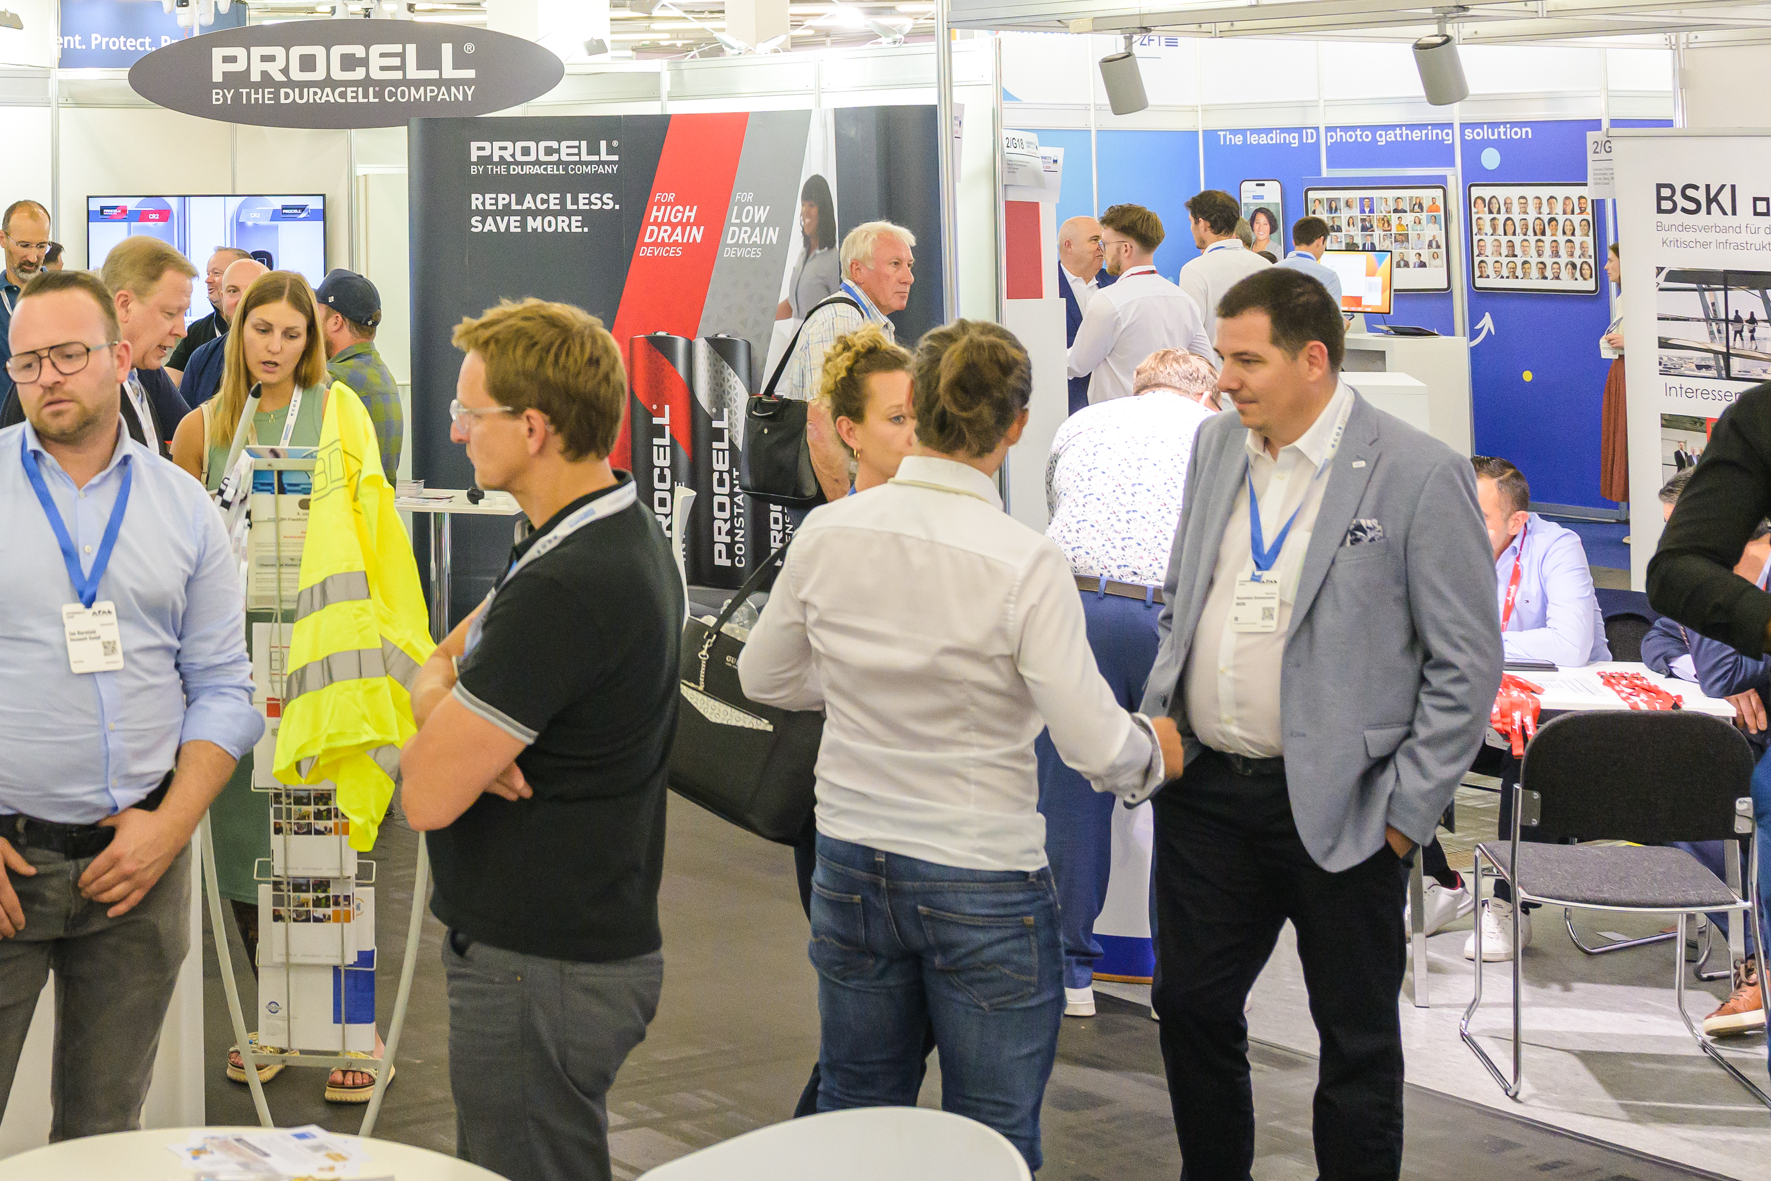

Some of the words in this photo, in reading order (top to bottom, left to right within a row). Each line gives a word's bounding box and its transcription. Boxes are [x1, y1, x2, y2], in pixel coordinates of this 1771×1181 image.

[57, 35, 86, 49] ent.
[91, 33, 156, 51] Protect.
[212, 88, 234, 105] BY
[239, 88, 275, 104] THE
[384, 85, 476, 102] COMPANY
[1005, 137, 1025, 149] 2/G18
[1218, 131, 1243, 145] The
[1247, 129, 1299, 147] leading
[1303, 129, 1317, 143] ID
[1327, 127, 1372, 146] photo
[1377, 126, 1453, 145] gathering
[1464, 124, 1532, 141] solution
[1592, 140, 1613, 154] 2/G
[470, 165, 484, 175] BY
[486, 165, 507, 175] THE
[568, 164, 619, 174] COMPANY
[471, 193, 561, 210] REPLACE
[566, 193, 620, 210] LESS.
[654, 192, 676, 203] FOR
[735, 192, 754, 203] FOR
[1655, 182, 1737, 216] BSKI
[649, 205, 698, 223] HIGH
[730, 205, 770, 224] LOW
[470, 215, 521, 232] SAVE
[527, 215, 588, 232] MORE.
[1656, 221, 1742, 235] Bundesverband
[1745, 223, 1762, 235] für
[1764, 224, 1771, 235] d
[643, 225, 704, 243] DRAIN
[726, 226, 780, 245] DRAIN
[639, 246, 683, 257] DEVICES
[723, 247, 762, 258] DEVICES
[1661, 237, 1713, 250] Kritischer
[1716, 239, 1771, 252] Infrastrukt
[1664, 382, 1742, 402] Interessen
[652, 404, 672, 538] ROCELL
[711, 407, 731, 567] PROCELL
